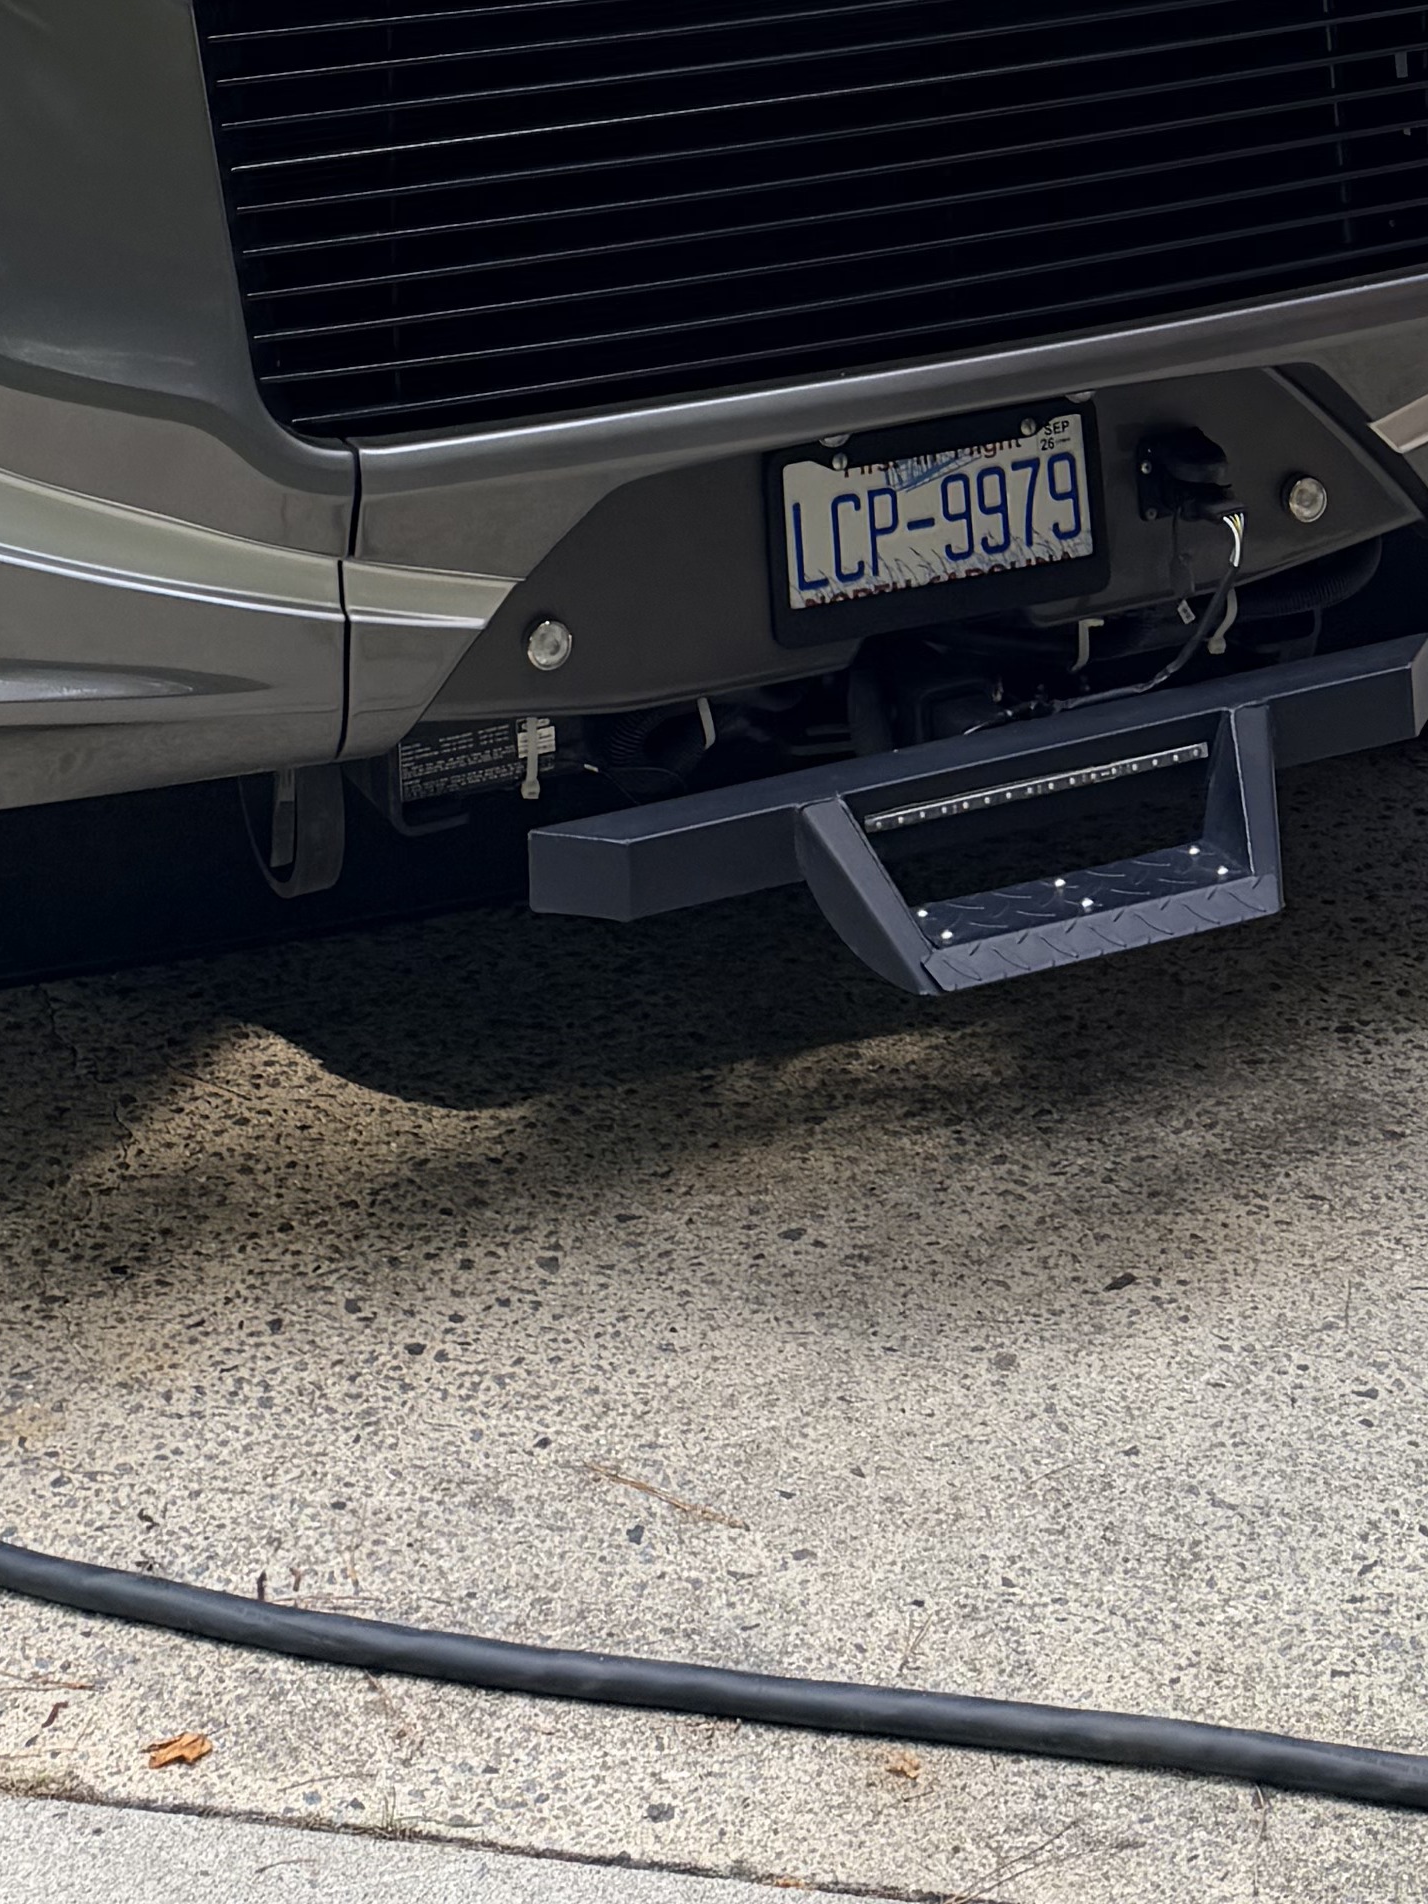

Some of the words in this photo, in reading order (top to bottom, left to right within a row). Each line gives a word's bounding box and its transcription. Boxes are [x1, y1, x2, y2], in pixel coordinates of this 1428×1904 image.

[1044, 420, 1070, 435] SEP
[1040, 437, 1055, 451] 26
[792, 452, 1082, 591] LCP-9979
